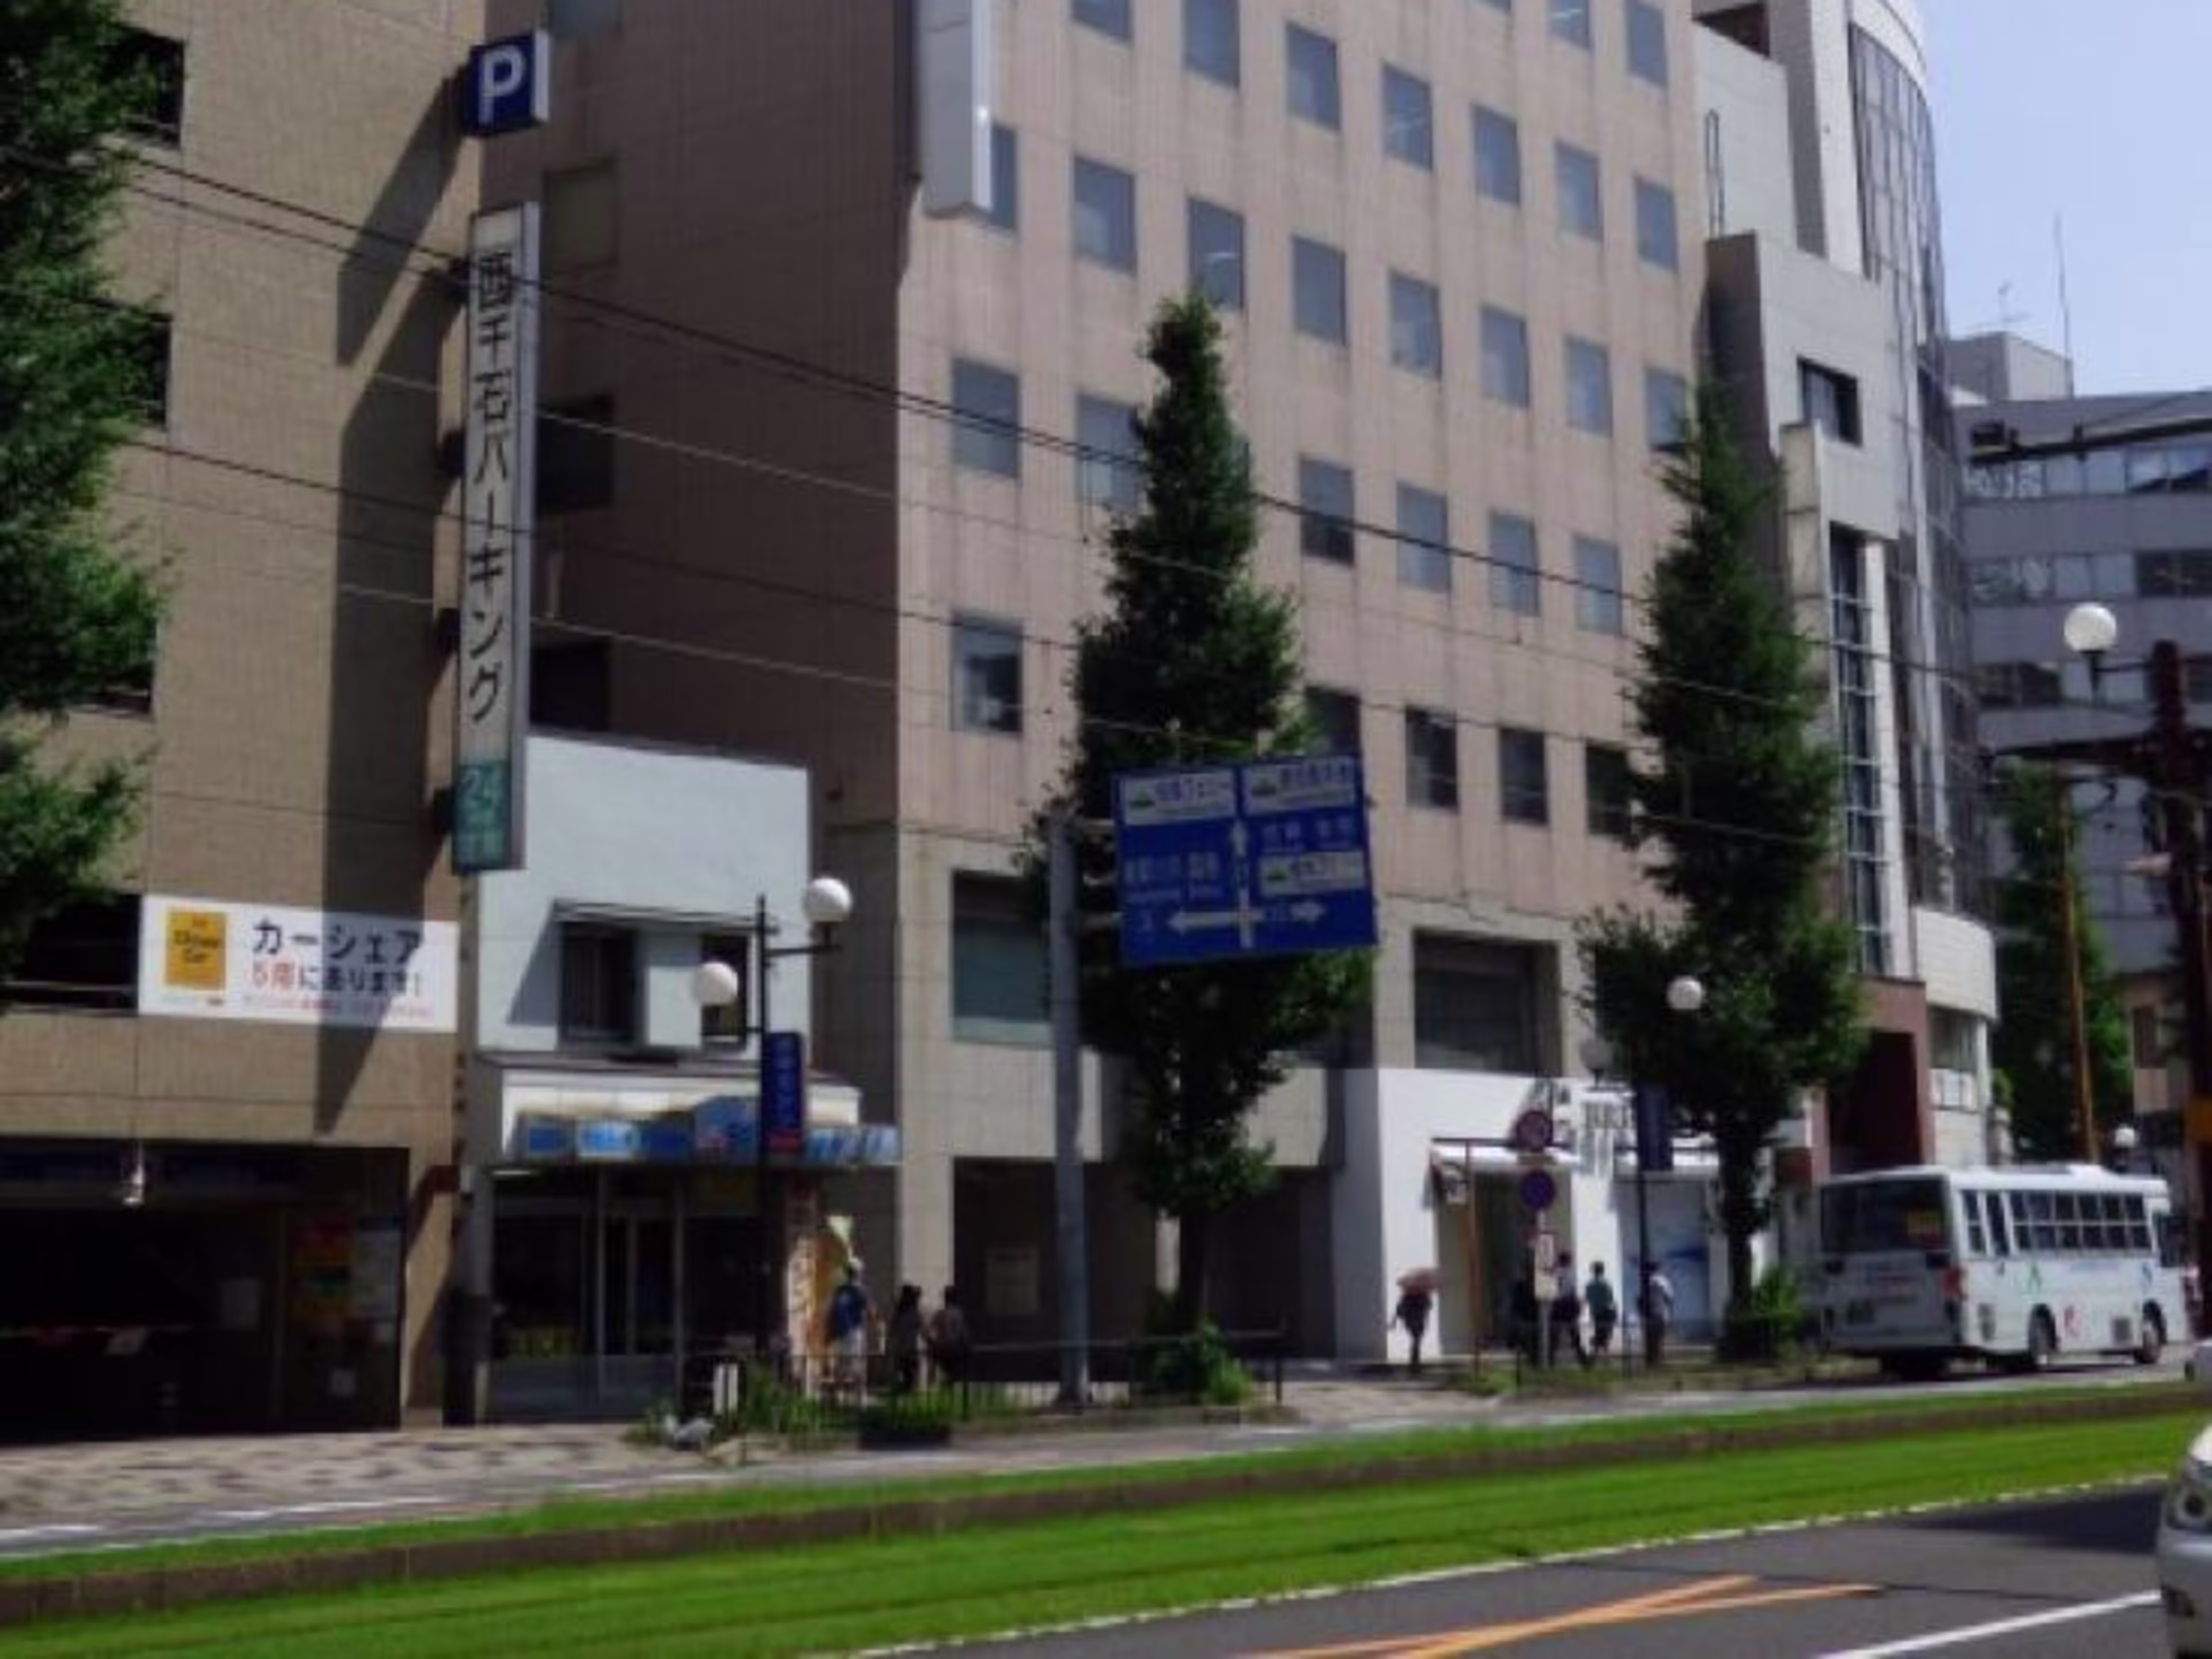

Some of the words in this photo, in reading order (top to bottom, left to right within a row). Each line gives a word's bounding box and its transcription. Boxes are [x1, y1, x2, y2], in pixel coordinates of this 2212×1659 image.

[478, 43, 526, 124] P
[252, 918, 421, 965] カーシェア
